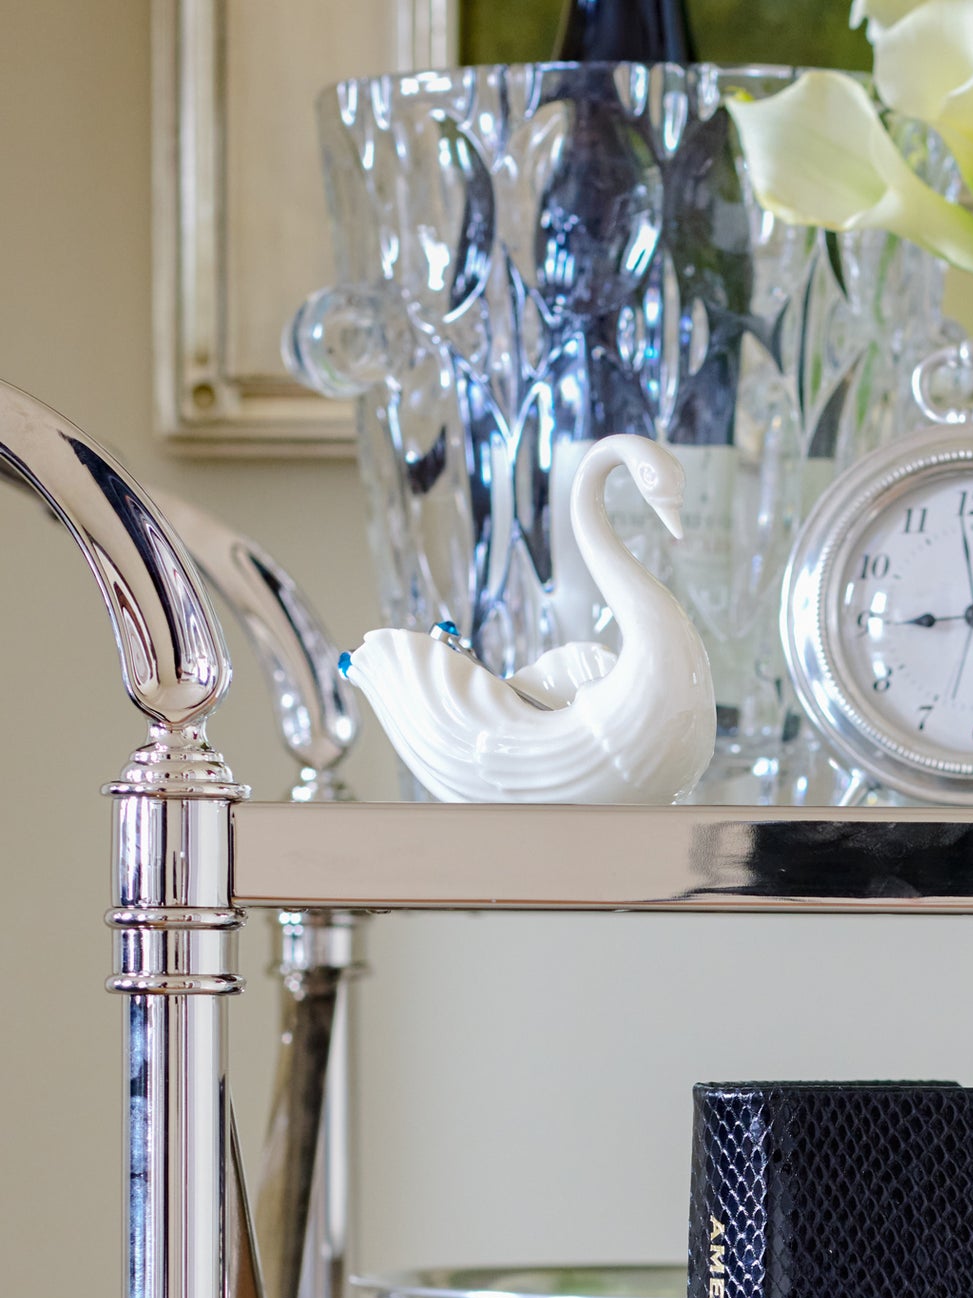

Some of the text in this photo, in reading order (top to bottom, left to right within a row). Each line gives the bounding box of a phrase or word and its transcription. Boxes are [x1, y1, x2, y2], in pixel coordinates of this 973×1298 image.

[903, 507, 928, 534] 11
[859, 553, 891, 581] 10
[856, 610, 875, 638] 9
[872, 665, 893, 693] 8
[917, 704, 936, 731] 7
